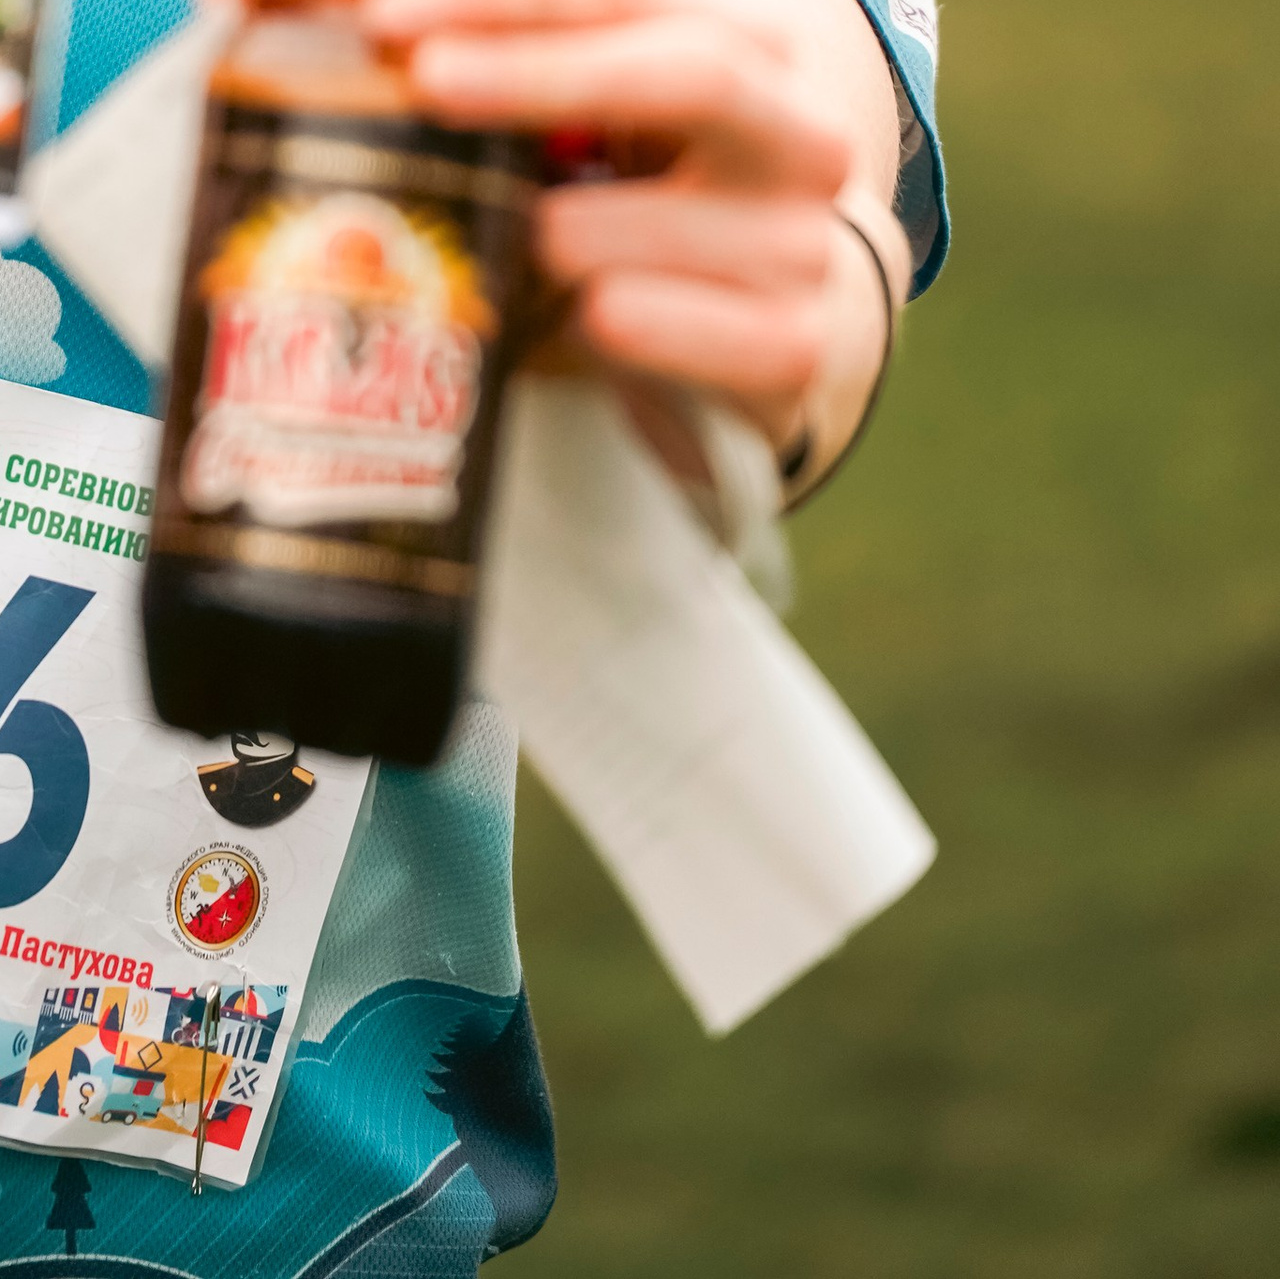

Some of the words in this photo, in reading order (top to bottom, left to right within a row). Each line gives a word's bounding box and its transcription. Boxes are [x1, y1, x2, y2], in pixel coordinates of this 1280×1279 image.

[5, 454, 156, 517] СОРЕВНОВ
[222, 867, 229, 877] N
[235, 844, 268, 883] ФЕДЕРАЦИЯ
[190, 890, 199, 901] W
